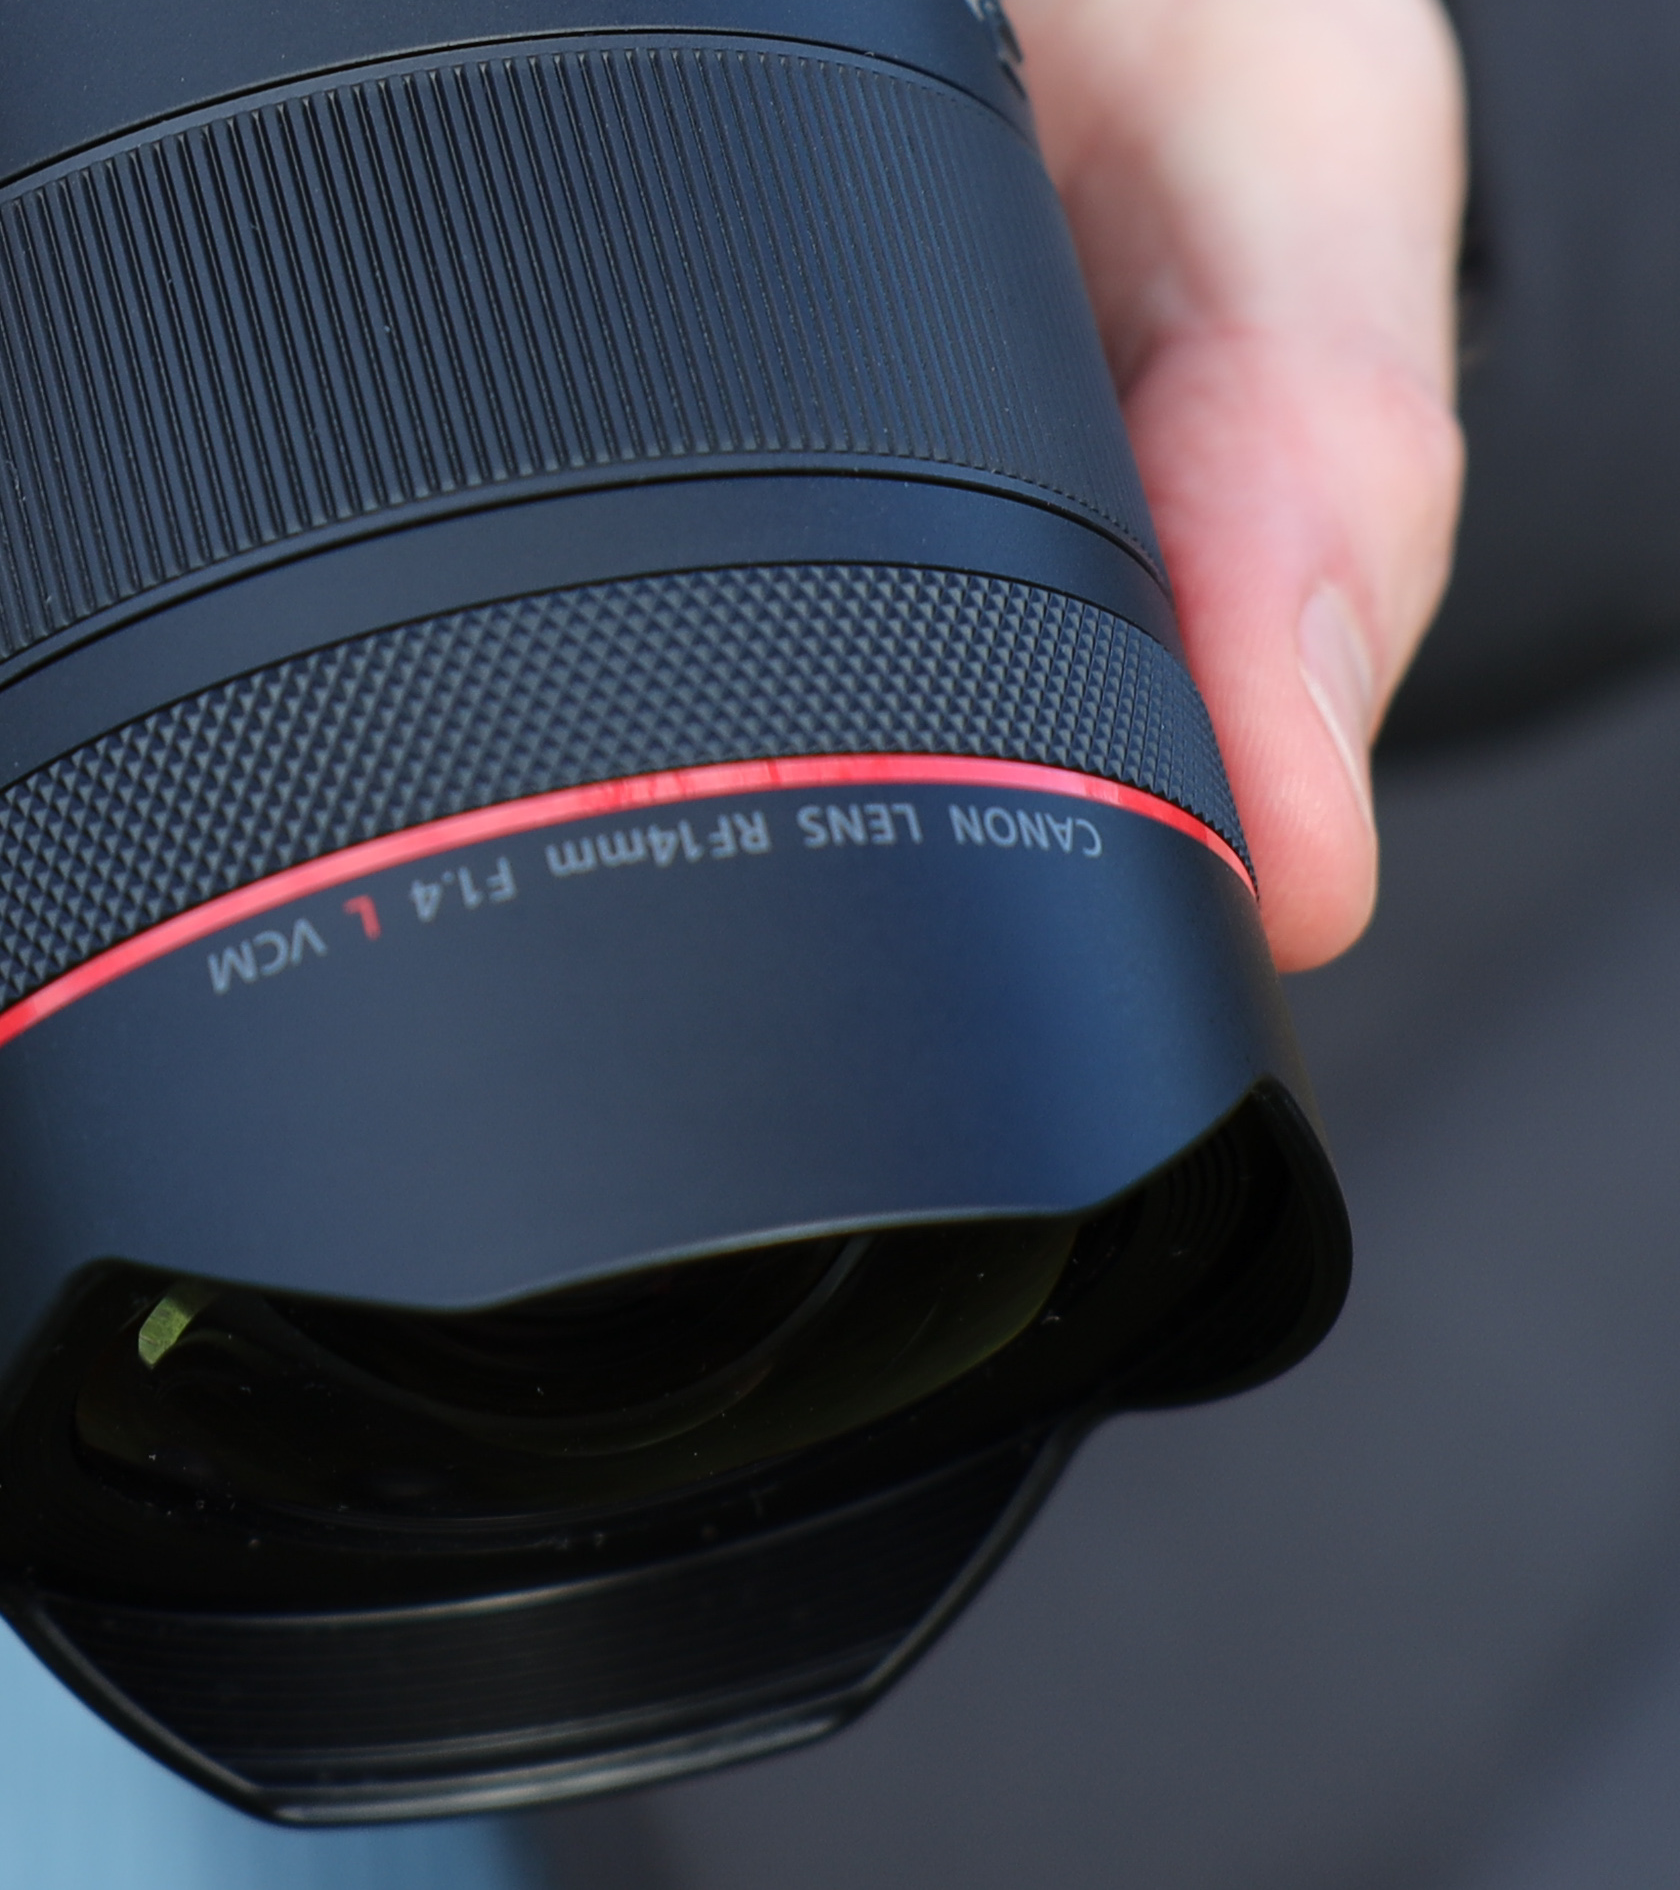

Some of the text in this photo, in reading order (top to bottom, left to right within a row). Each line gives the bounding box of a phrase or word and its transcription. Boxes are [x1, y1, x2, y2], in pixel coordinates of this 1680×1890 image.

[206, 803, 1104, 992] CANON LENS RF14mm F1.4 L VCM
